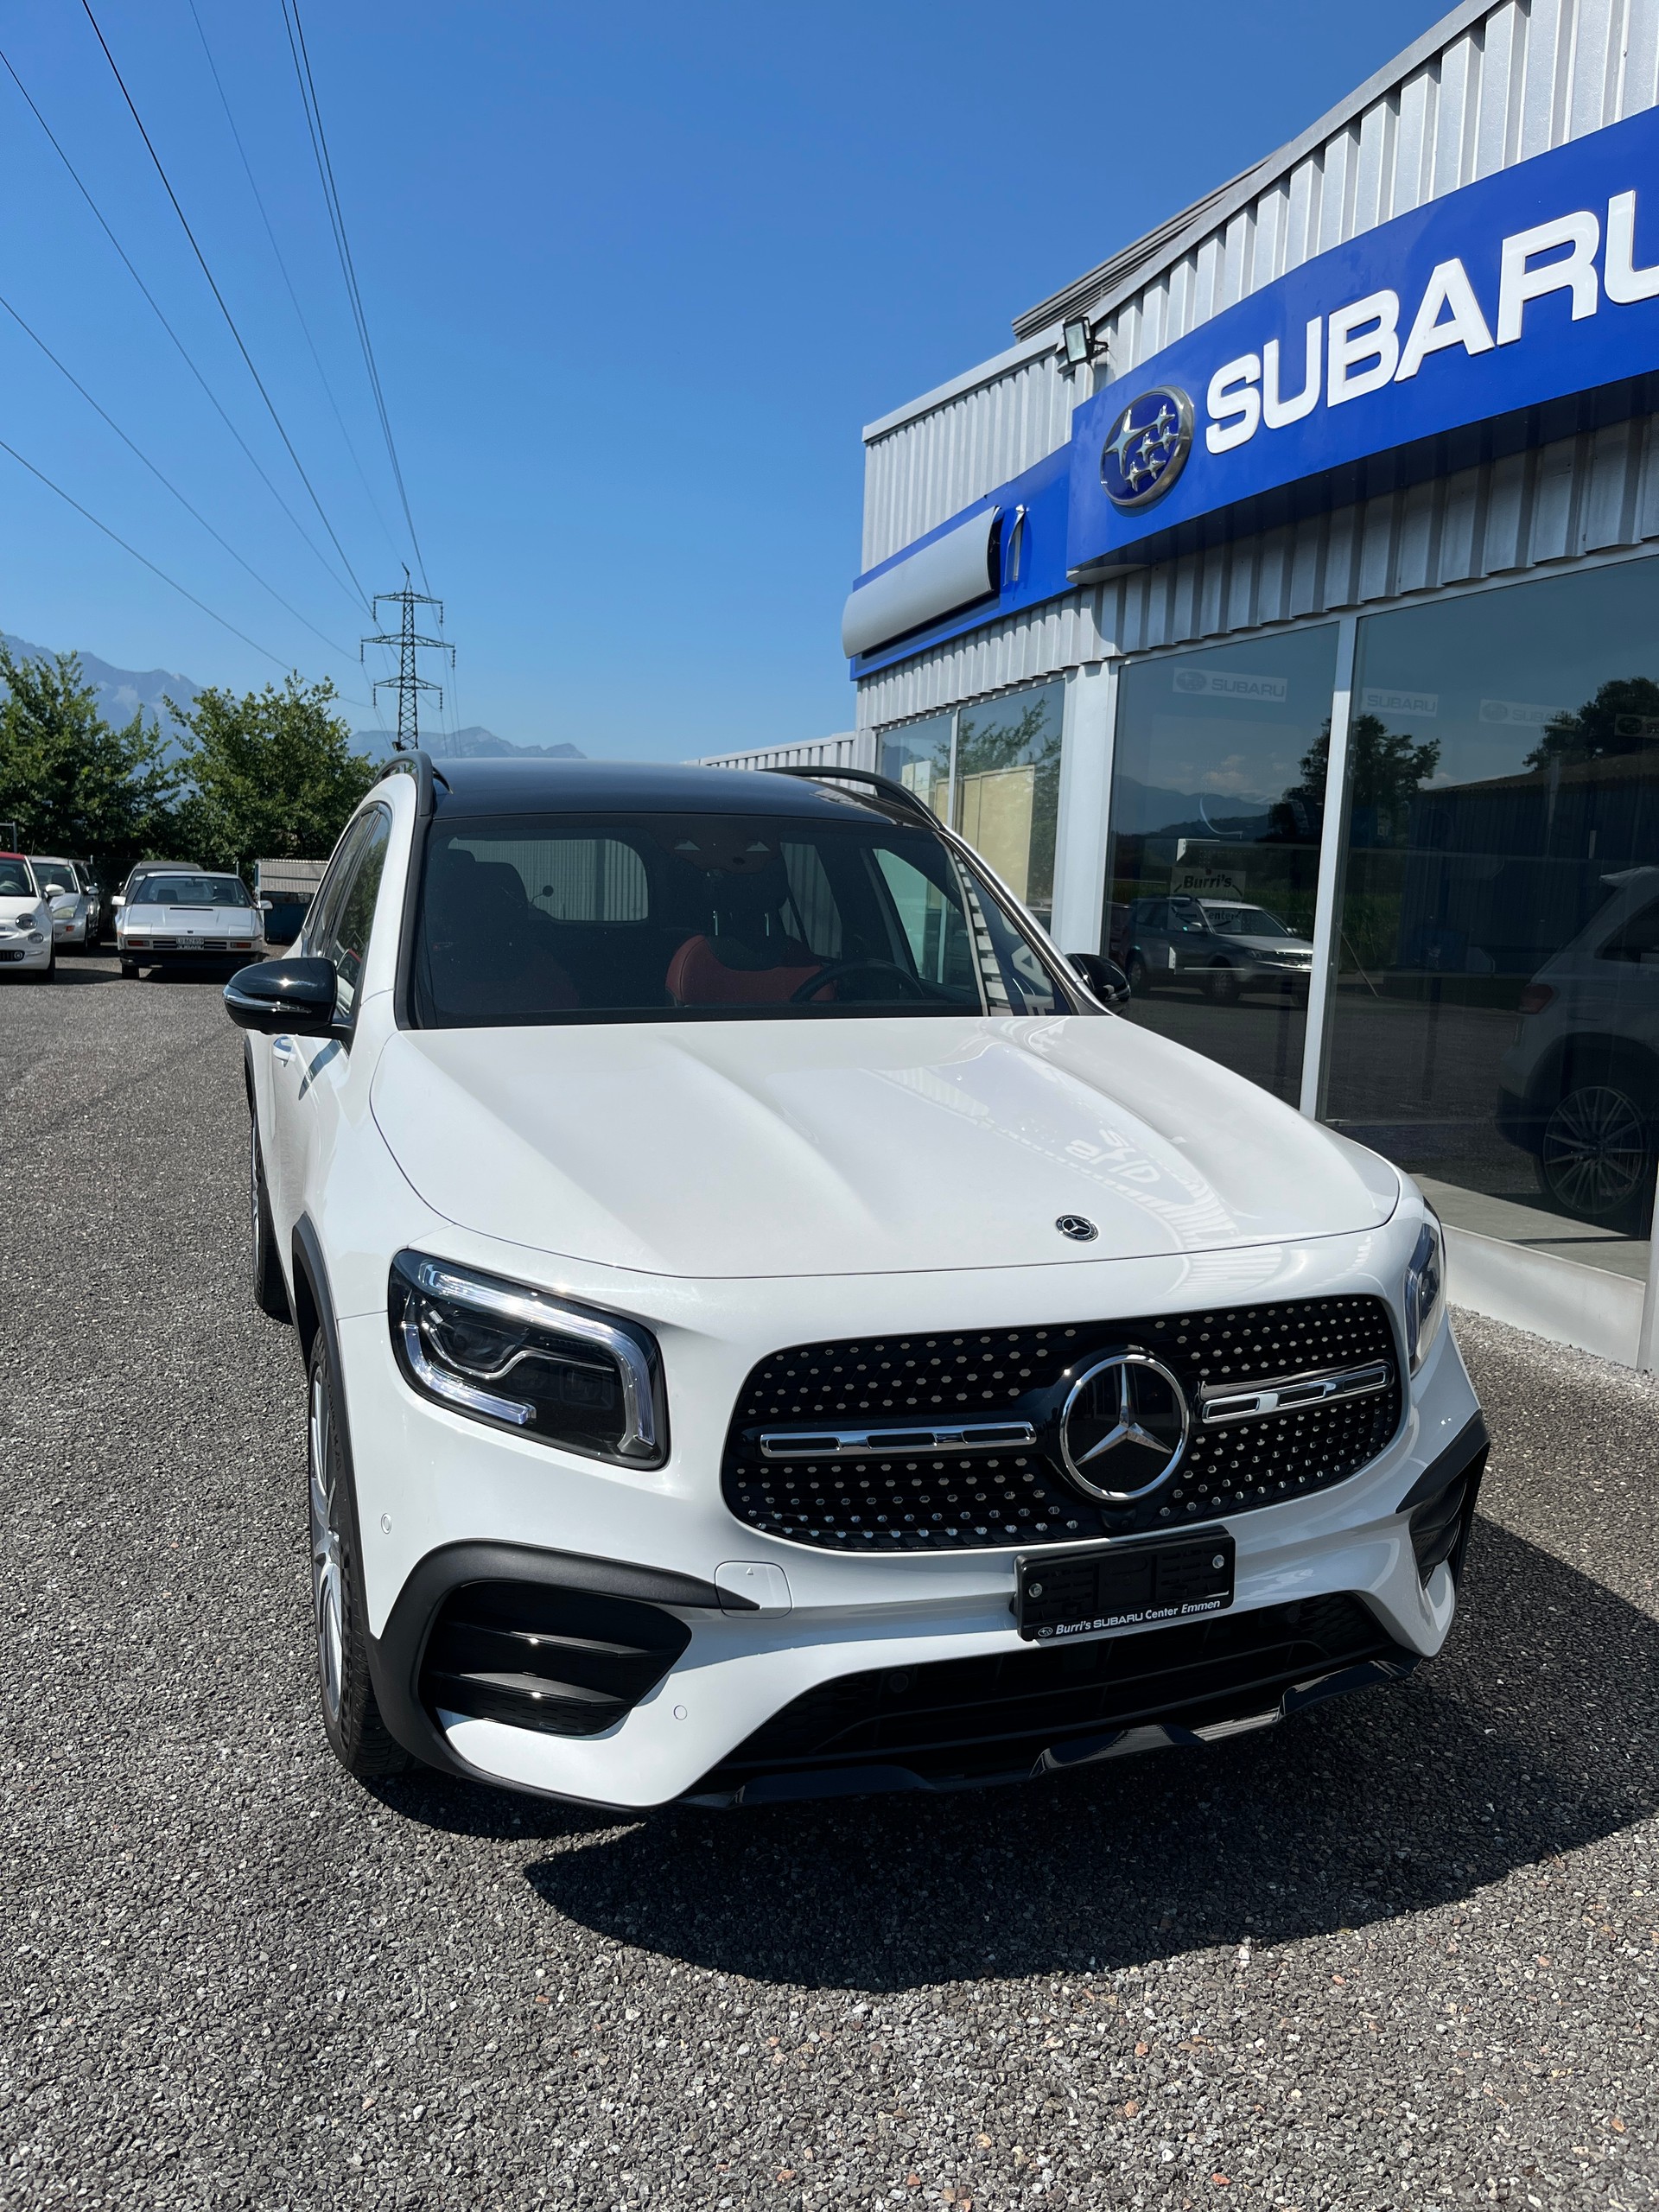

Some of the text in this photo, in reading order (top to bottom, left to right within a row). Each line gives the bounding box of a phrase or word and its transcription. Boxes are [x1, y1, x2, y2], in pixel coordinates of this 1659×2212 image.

[1205, 189, 1659, 454] SUBARU
[1211, 677, 1286, 697] SUBARU
[1367, 694, 1436, 713] SUBARU
[1183, 874, 1232, 889] Burri's
[1205, 909, 1234, 920] enter
[1055, 1599, 1221, 1635] Burri's SUBARU Center Emmen
